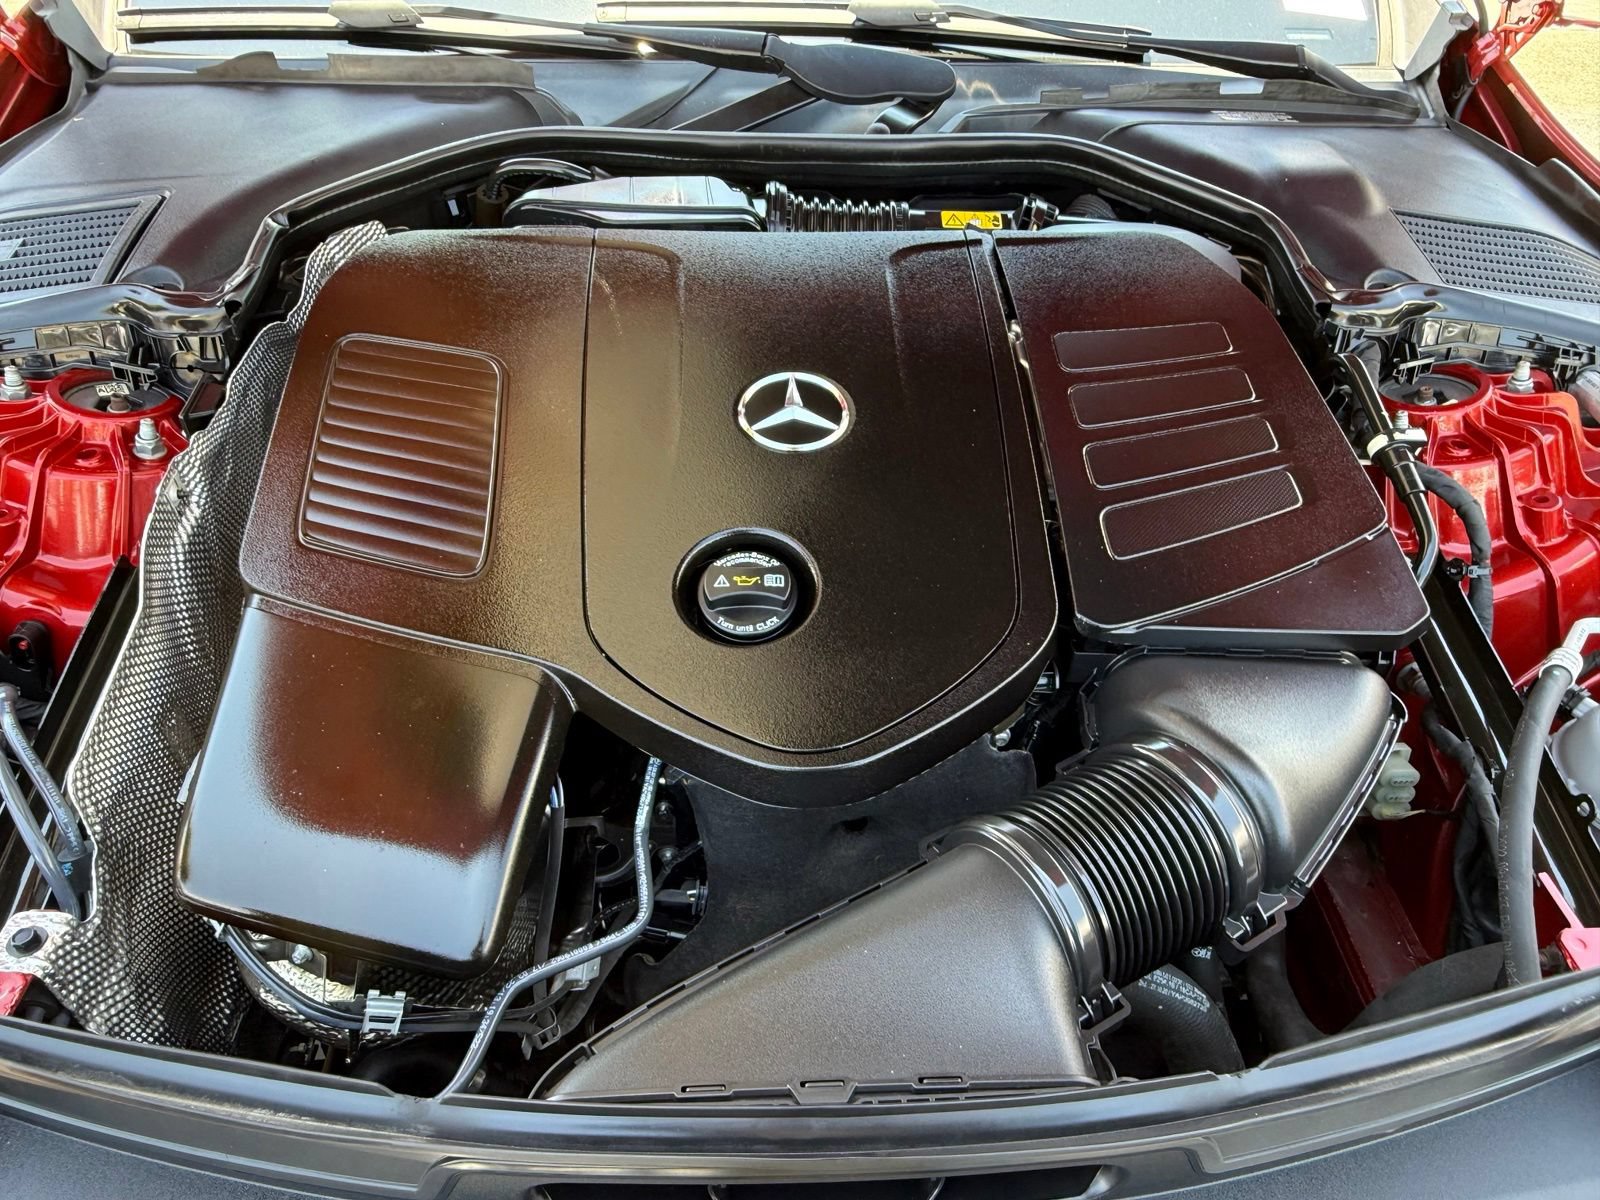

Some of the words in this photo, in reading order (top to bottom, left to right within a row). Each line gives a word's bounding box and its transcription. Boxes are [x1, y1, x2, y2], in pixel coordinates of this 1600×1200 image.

[713, 552, 770, 567] Mercedes-Benz
[716, 616, 734, 630] Turn
[736, 624, 754, 632] until
[756, 615, 780, 631] CLICK
